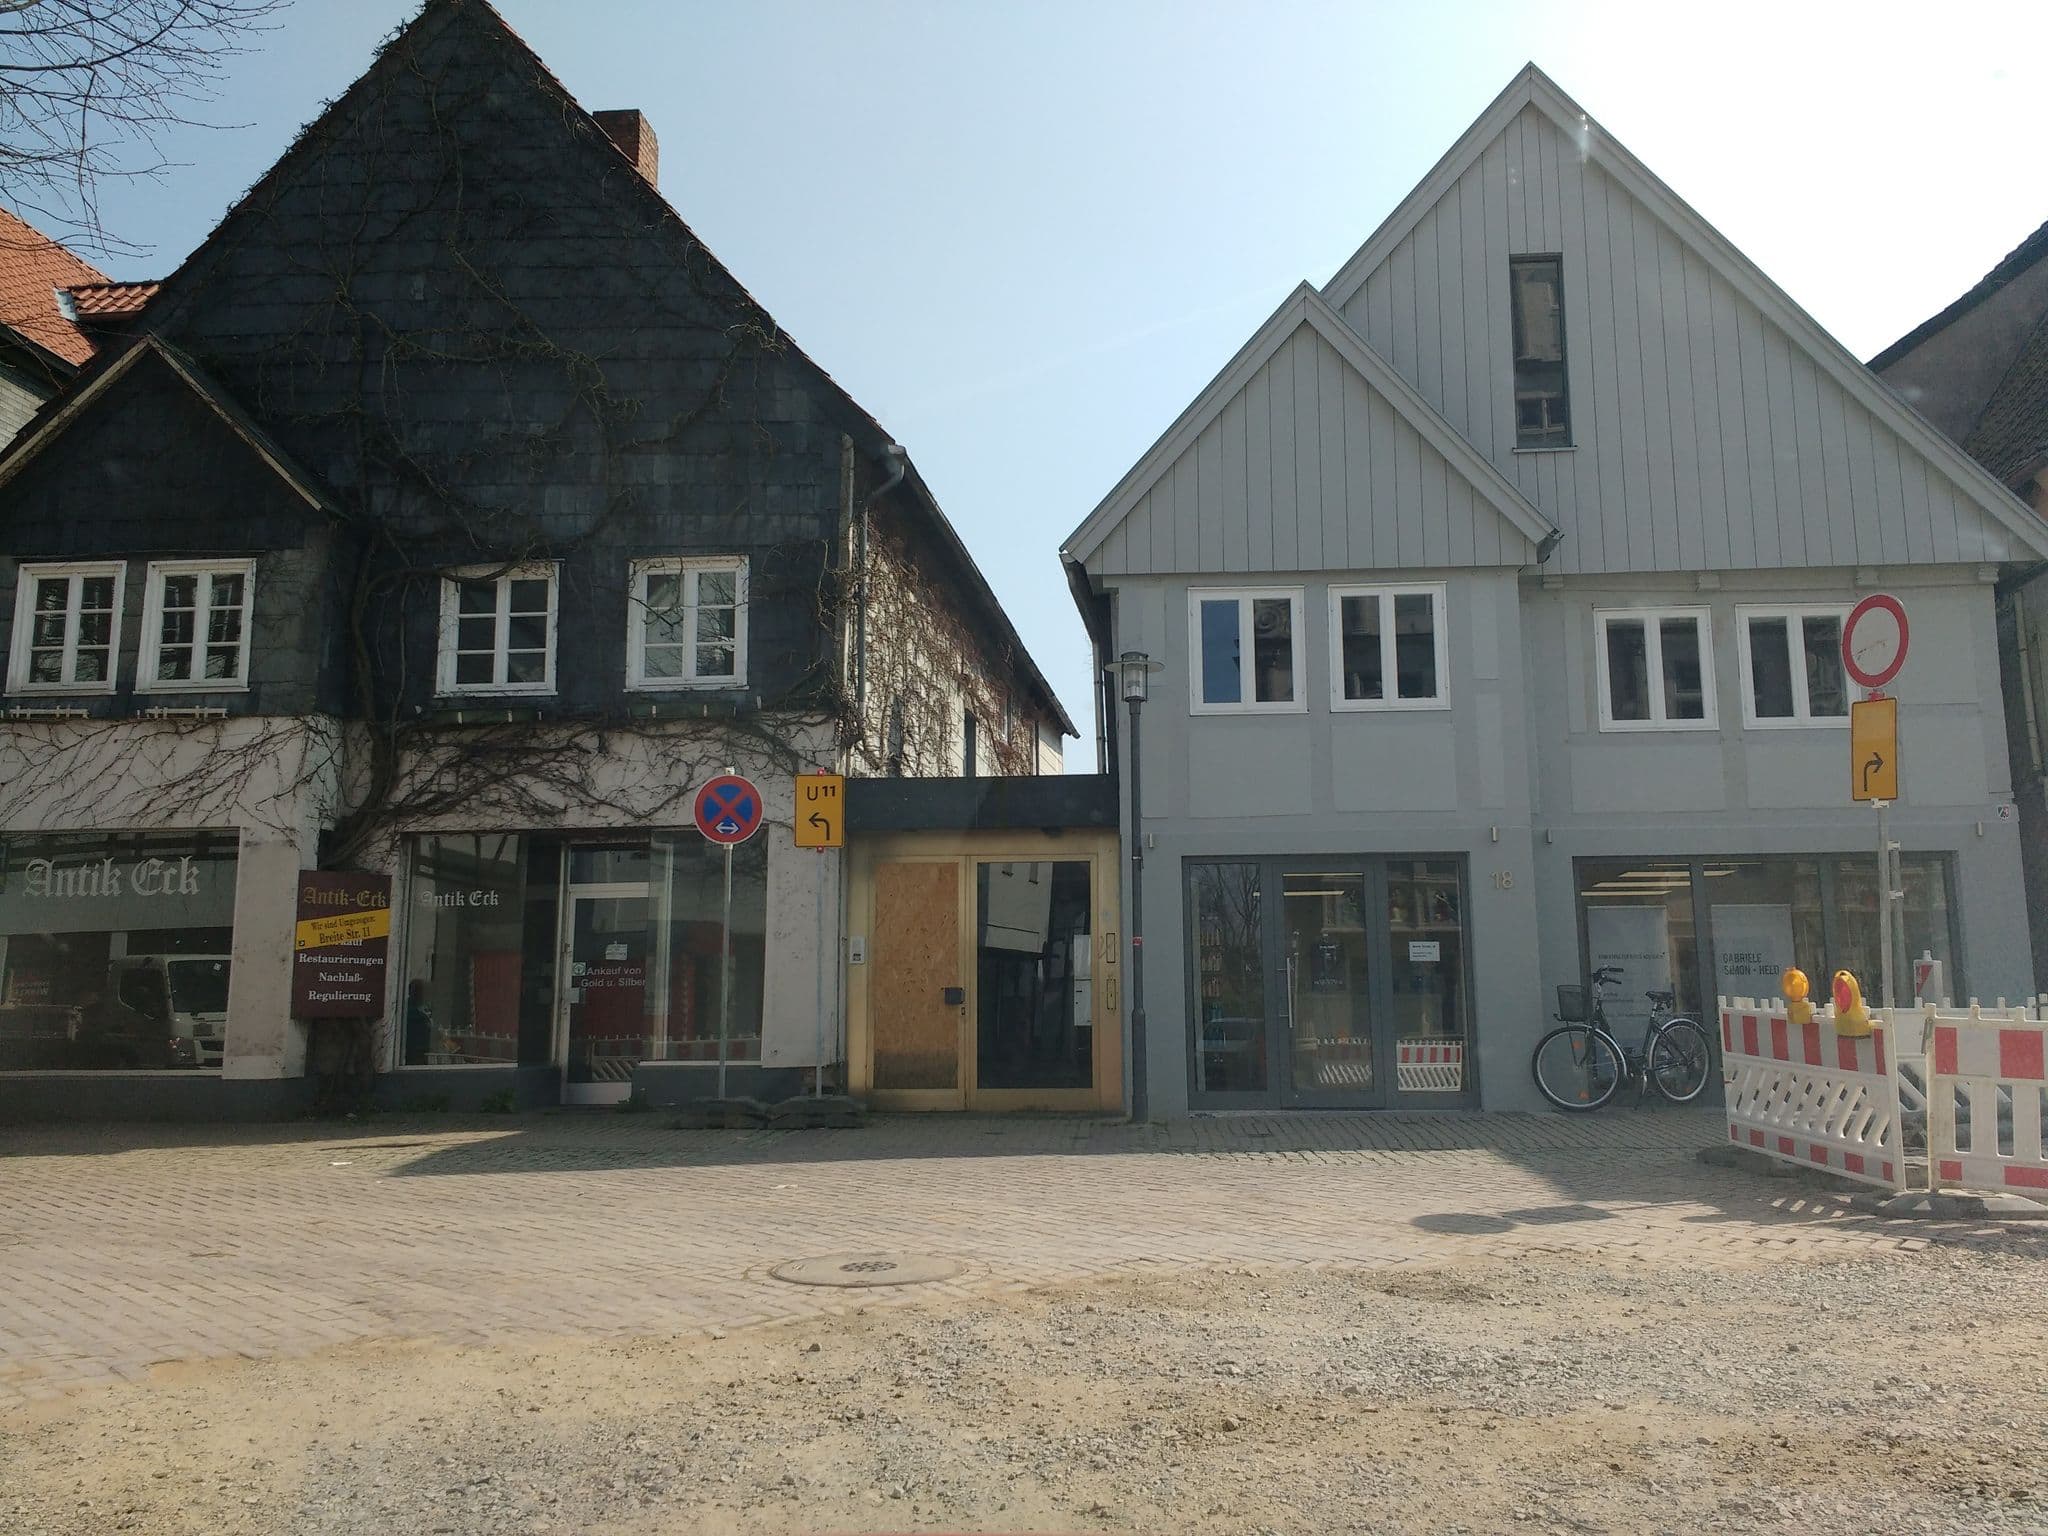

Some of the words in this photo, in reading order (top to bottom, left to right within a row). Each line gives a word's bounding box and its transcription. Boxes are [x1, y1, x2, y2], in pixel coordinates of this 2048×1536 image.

[807, 785, 819, 801] U
[822, 785, 836, 797] 11
[22, 856, 123, 898] Antik
[131, 855, 201, 897] Eck
[1491, 870, 1513, 889] 18
[303, 886, 387, 908] Antik-Eck
[421, 890, 465, 907] Antik
[469, 889, 499, 906] Eck
[319, 930, 345, 944] Breite
[346, 928, 361, 940] Str.
[363, 926, 371, 937] 11
[299, 953, 384, 967] Restaurierungen
[1723, 953, 1762, 964] GABRIELE
[586, 966, 621, 976] Ankauf
[623, 967, 642, 976] von
[1724, 965, 1751, 975] SIMON
[1759, 965, 1780, 975] HELD
[319, 972, 364, 983] Nachlaß-
[581, 978, 604, 988] Gold
[618, 977, 646, 987] Silber
[308, 990, 372, 1003] Regulierung
